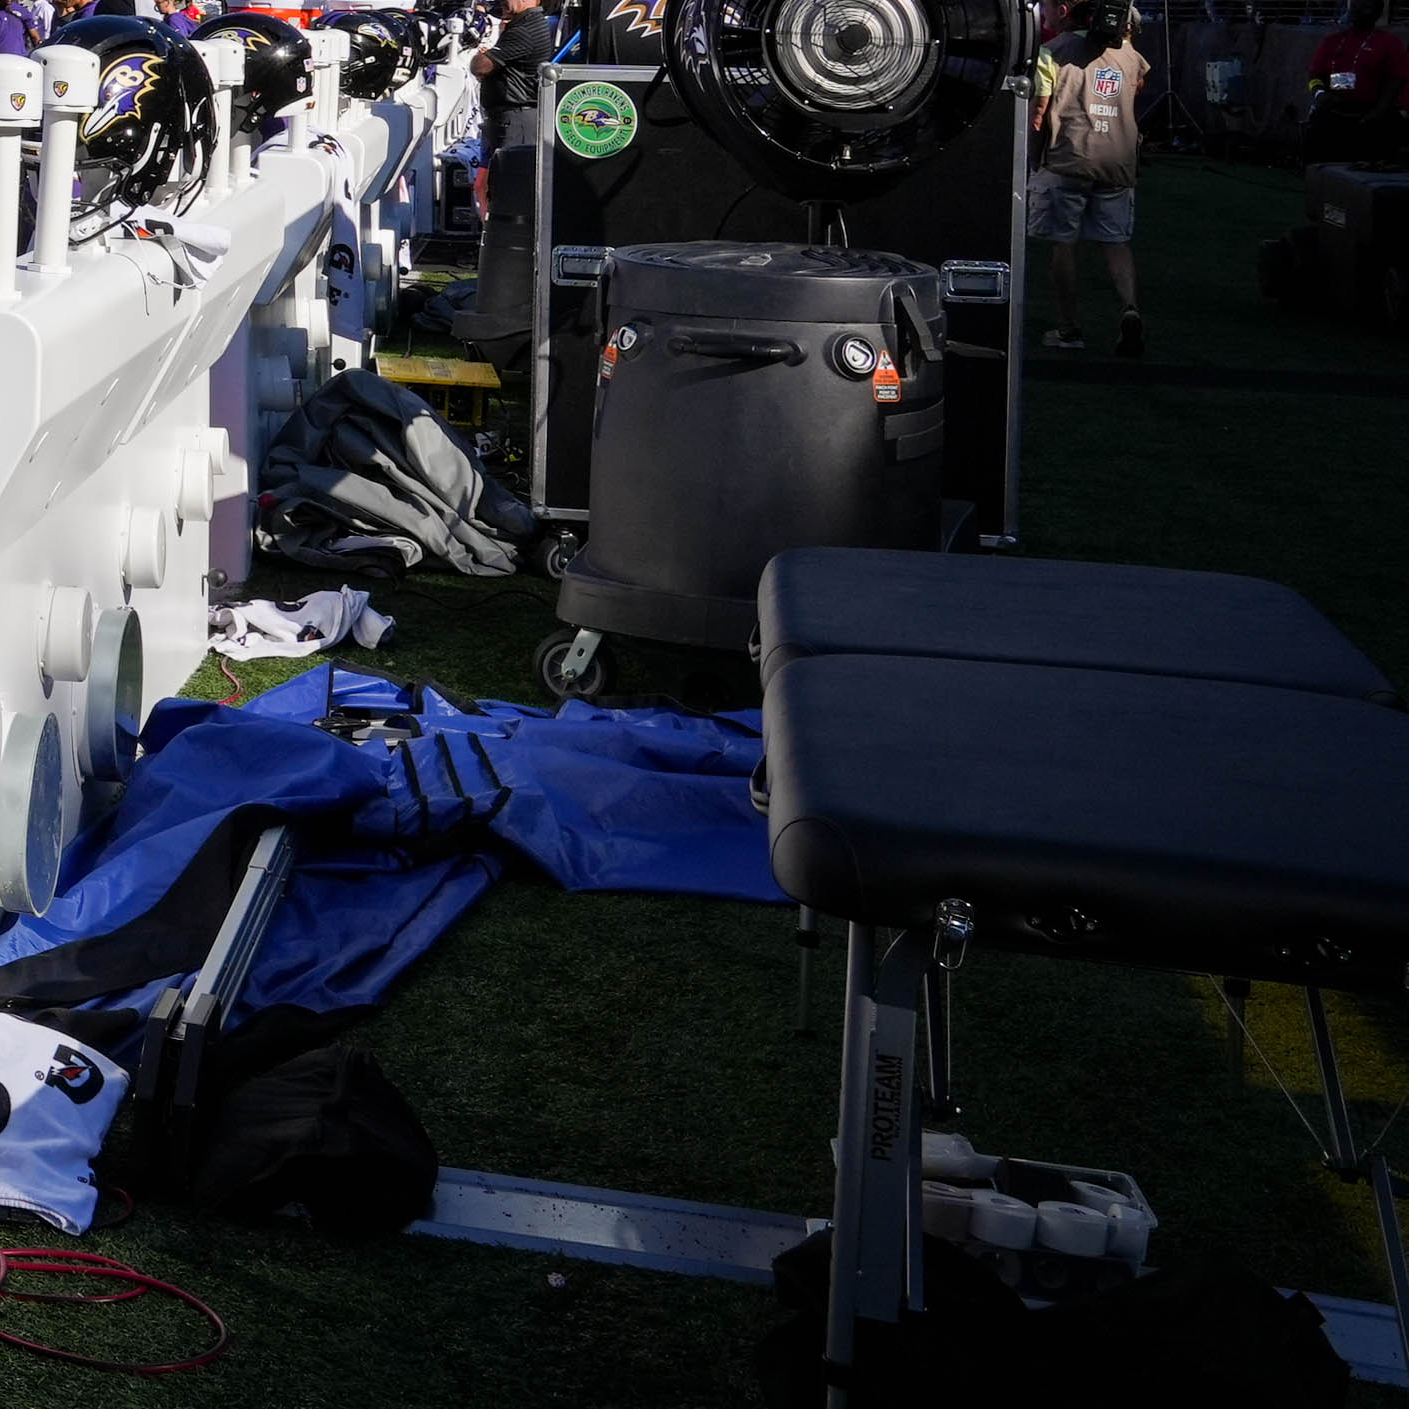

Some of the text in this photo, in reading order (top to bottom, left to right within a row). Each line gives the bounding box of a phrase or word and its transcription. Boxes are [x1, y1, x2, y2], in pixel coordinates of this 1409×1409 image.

[1096, 79, 1117, 95] NFL
[564, 86, 630, 112] BALTIMORE RAVENS
[1089, 103, 1118, 118] MEDIA
[1094, 119, 1110, 133] 95
[584, 129, 629, 154] EQUIPMENT
[871, 1054, 896, 1162] PROTEAM
